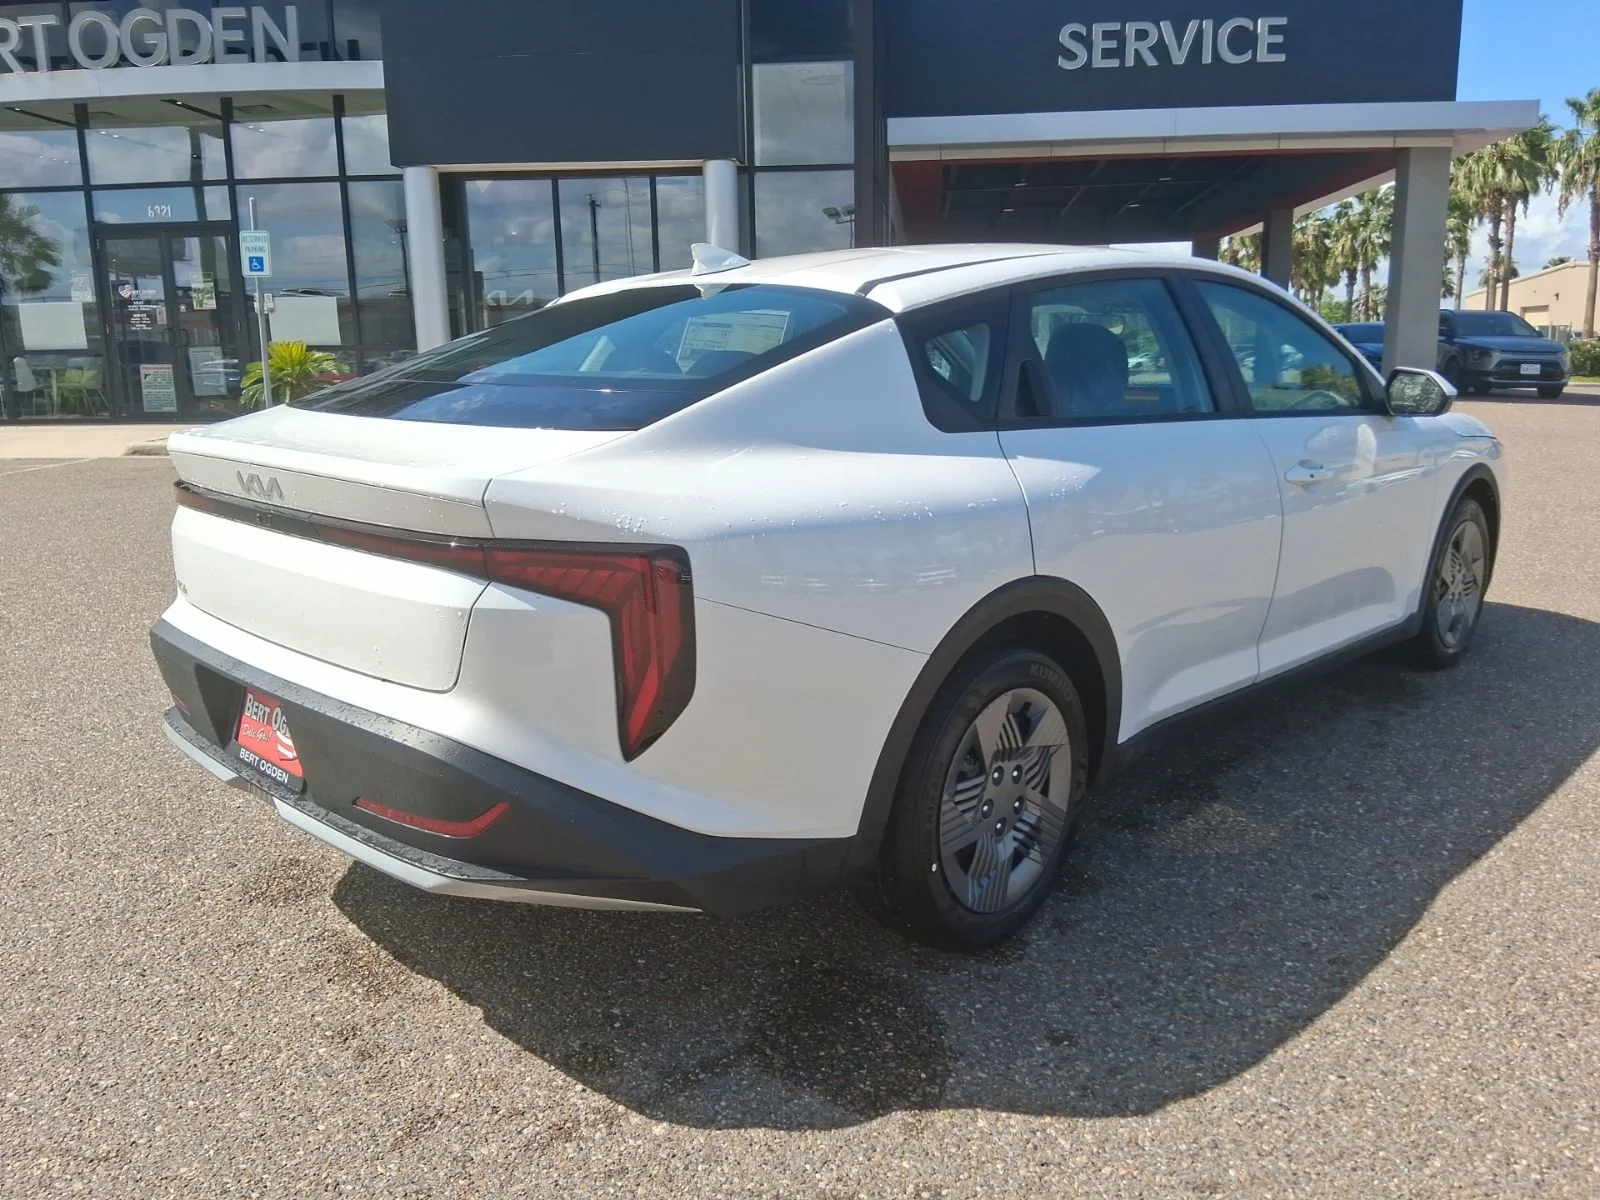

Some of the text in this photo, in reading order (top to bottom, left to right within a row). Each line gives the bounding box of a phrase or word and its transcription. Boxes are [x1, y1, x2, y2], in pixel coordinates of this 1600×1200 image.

[68, 6, 299, 69] OGDEN
[1058, 17, 1288, 70] SERVICE
[242, 236, 269, 244] RESERVED
[244, 693, 271, 725] BERT
[239, 747, 290, 784] BERT OGDEN
